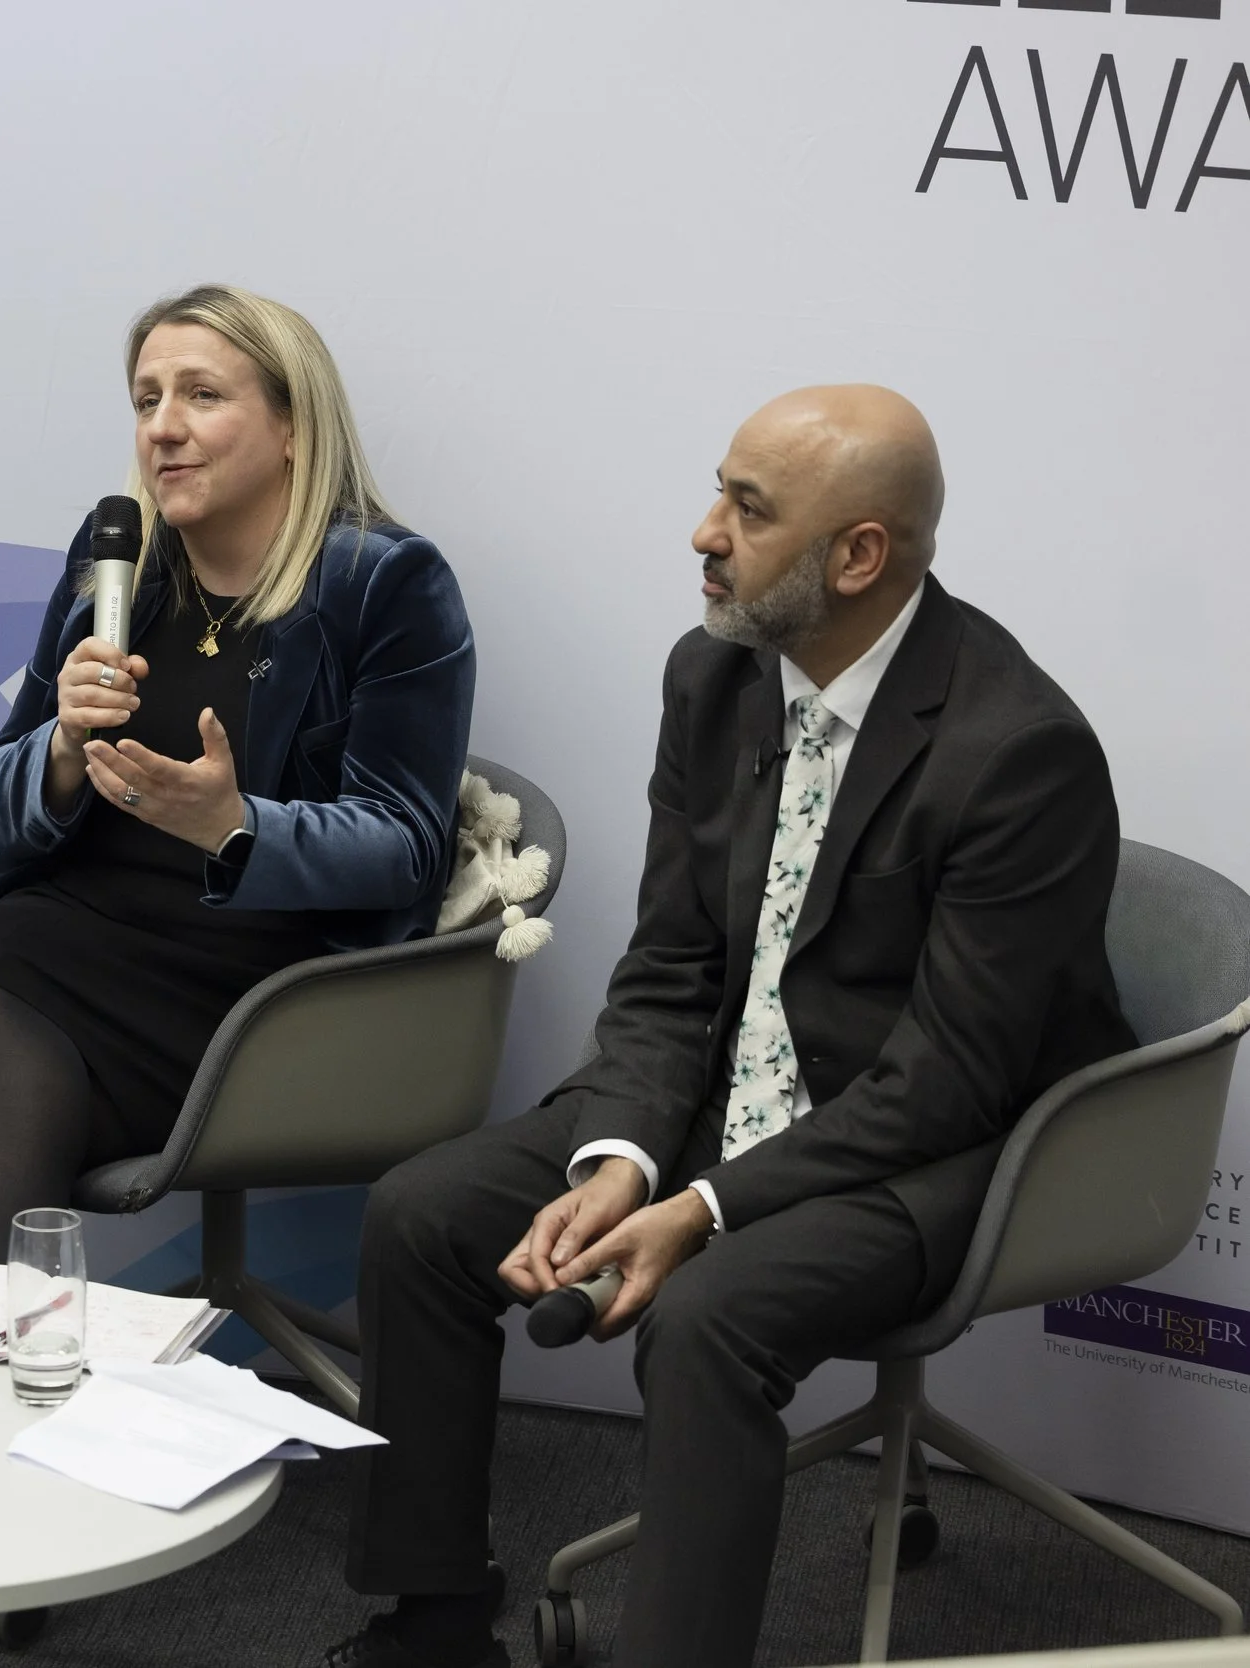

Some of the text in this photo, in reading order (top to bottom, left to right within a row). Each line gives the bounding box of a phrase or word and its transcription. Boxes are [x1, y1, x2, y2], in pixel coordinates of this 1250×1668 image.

[915, 46, 1250, 212] AWA
[110, 622, 117, 631] TO
[111, 611, 118, 621] SB
[1211, 1169, 1244, 1191] RY
[1205, 1203, 1241, 1225] CE
[1196, 1234, 1241, 1258] TIT
[1163, 1332, 1207, 1356] 1824
[1044, 1339, 1250, 1394] The University of Mancheste
